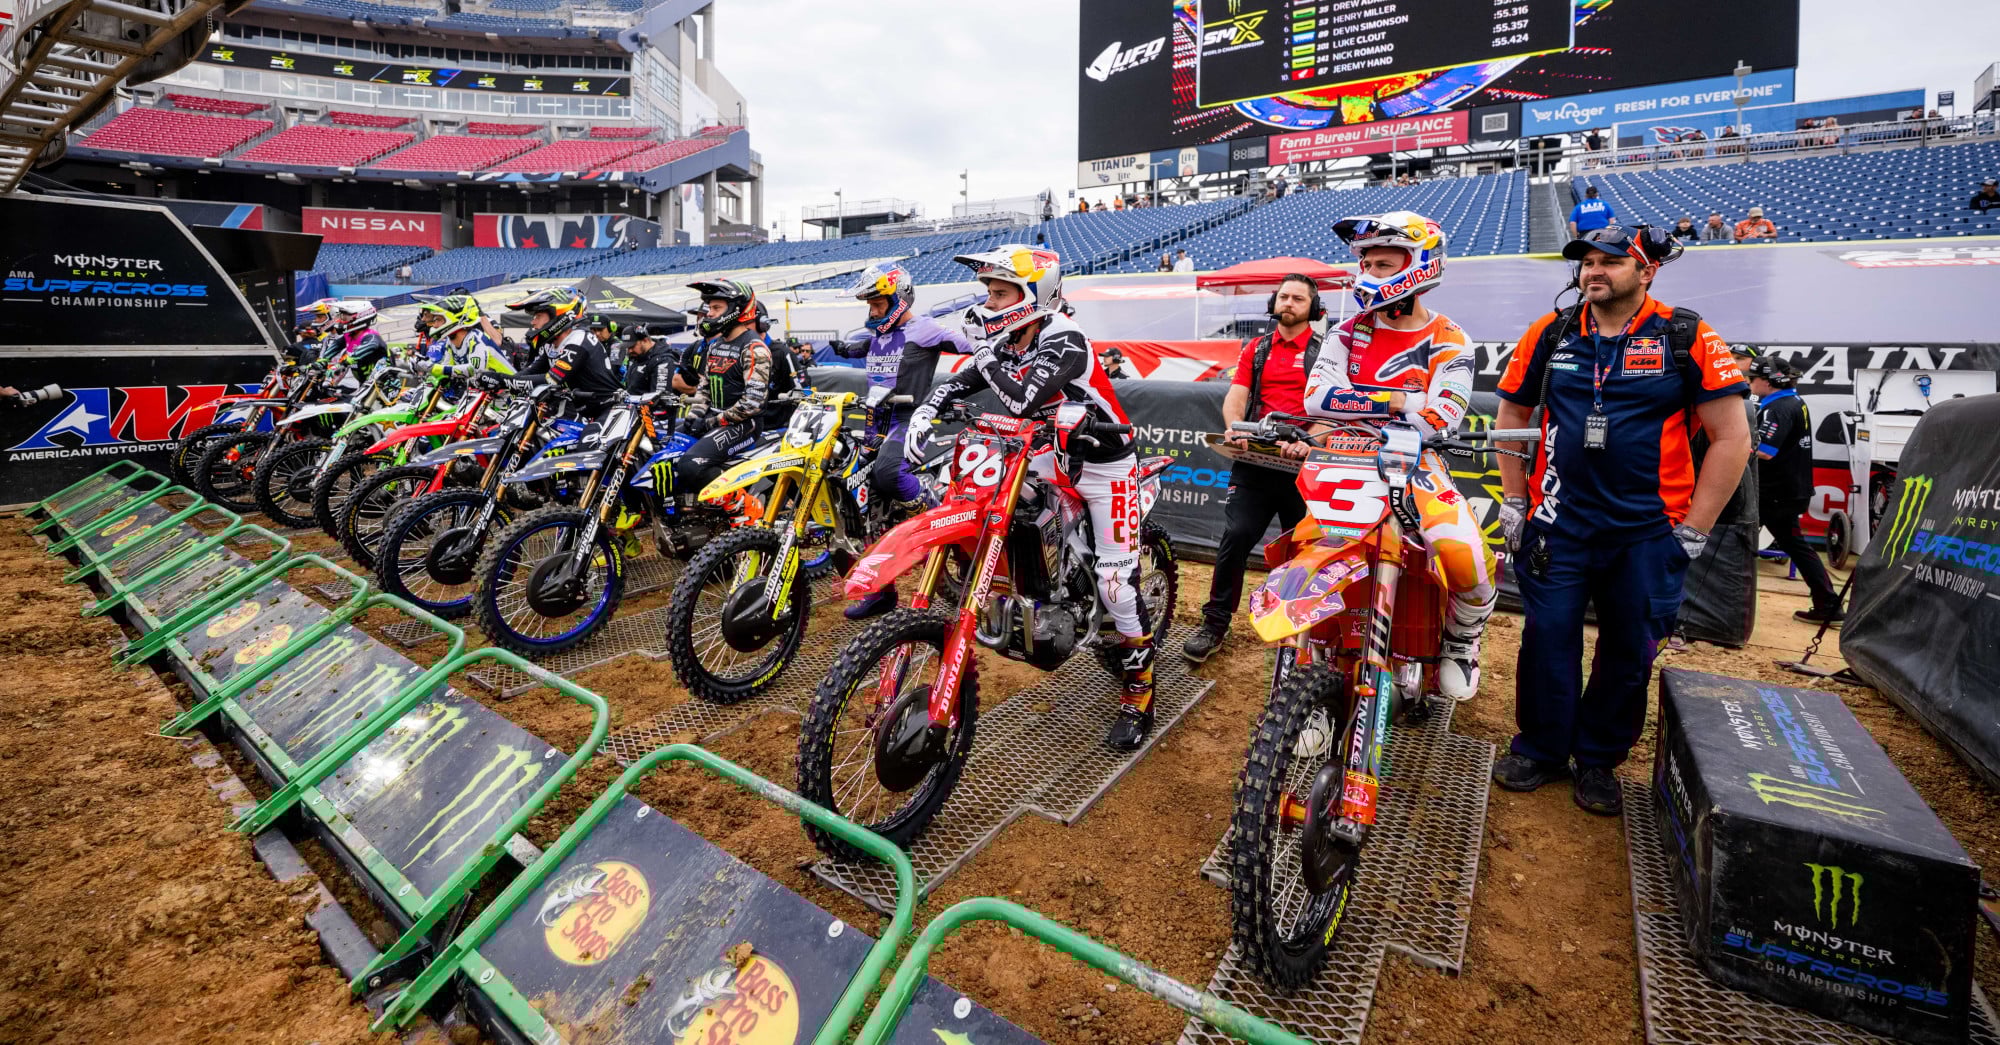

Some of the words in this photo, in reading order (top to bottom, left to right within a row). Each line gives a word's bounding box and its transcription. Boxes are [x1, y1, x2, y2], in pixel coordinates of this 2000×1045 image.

[1333, 1, 1359, 12] DREW
[1333, 13, 1362, 24] HENRY
[1363, 5, 1396, 18] MILLER
[1493, 5, 1529, 20] :55.316
[1203, 16, 1266, 46] SMX
[1333, 25, 1359, 37] DEVIN
[1360, 15, 1409, 31] SIMONSON
[1493, 20, 1529, 34] :55.357
[1332, 38, 1355, 49] LUKE
[1356, 32, 1386, 45] CLOUT
[1492, 33, 1530, 48] :55.424
[1112, 36, 1166, 69] UFO
[1332, 50, 1354, 61] NICK
[1354, 43, 1394, 58] ROMANO
[1332, 61, 1366, 74] JEREMY
[1367, 57, 1393, 68] HAND
[1555, 102, 1605, 127] Kroger
[1614, 100, 1656, 115] FRESH
[1660, 96, 1690, 109] FOR
[1279, 137, 1313, 150] Farm
[1315, 131, 1360, 146] Bureau
[1311, 149, 1330, 158] Home
[1340, 146, 1354, 155] Life
[1091, 158, 1121, 172] TITAN
[1121, 155, 1137, 168] UP
[321, 215, 425, 233] NISSAN
[8, 270, 35, 279] AMA
[72, 269, 149, 279] ENERGY
[1379, 275, 1415, 301] Red
[1412, 256, 1441, 285] Bull
[1, 278, 209, 298] SUPERCROSS
[51, 296, 168, 309] CHAMPIONSHIP
[877, 316, 894, 335] Red
[892, 300, 908, 321] Bull
[985, 314, 1010, 336] Red
[1009, 303, 1035, 325] Bull
[1626, 347, 1644, 355] Red
[1644, 346, 1664, 355] Bull
[1630, 358, 1658, 366] KTM
[1329, 398, 1351, 412] Red
[1351, 399, 1373, 413] Bull
[1443, 403, 1459, 420] BELL
[978, 420, 1016, 433] RENTHAL
[983, 413, 1019, 425] RENTHAL
[713, 424, 745, 451] FLY
[733, 438, 755, 453] YAMAHA
[1329, 442, 1381, 453] RENTHA
[9, 447, 92, 462] AMERICAN
[771, 456, 805, 470] PROGRESSIVE
[956, 442, 1008, 487] 96
[604, 467, 627, 507] KYB
[1305, 467, 1391, 525] 3
[473, 498, 492, 537] DUNLOP
[1390, 488, 1412, 527] OAKLEY
[929, 509, 977, 531] PROGRESSIVE
[575, 516, 596, 561] DUNLOP
[1330, 526, 1362, 538] MOTOREX
[611, 542, 622, 577] DUNLOP
[781, 546, 796, 581] ACERBIS
[982, 541, 1003, 590] SHOWA
[1097, 557, 1134, 571] insta360
[765, 545, 787, 600] DUNLOP
[940, 638, 967, 714] DUNLOP
[1376, 678, 1391, 745] MOTOREX
[1750, 709, 1778, 748] ENERGY
[1756, 687, 1841, 789] SUPERCROSS
[1799, 711, 1855, 773] CHAMPIONSHIP
[605, 867, 644, 907] Bass
[583, 891, 617, 925] Pro
[1325, 884, 1350, 947] DUNLOP
[561, 913, 614, 963] Shops
[1729, 926, 1754, 940] AMA
[1791, 939, 1875, 969] ENERGY
[1722, 931, 1949, 1008] SUPERCROSS
[737, 959, 790, 1014] Bass
[1765, 960, 1899, 1009] CHAMPIONSHIP
[715, 991, 759, 1036] Pro
